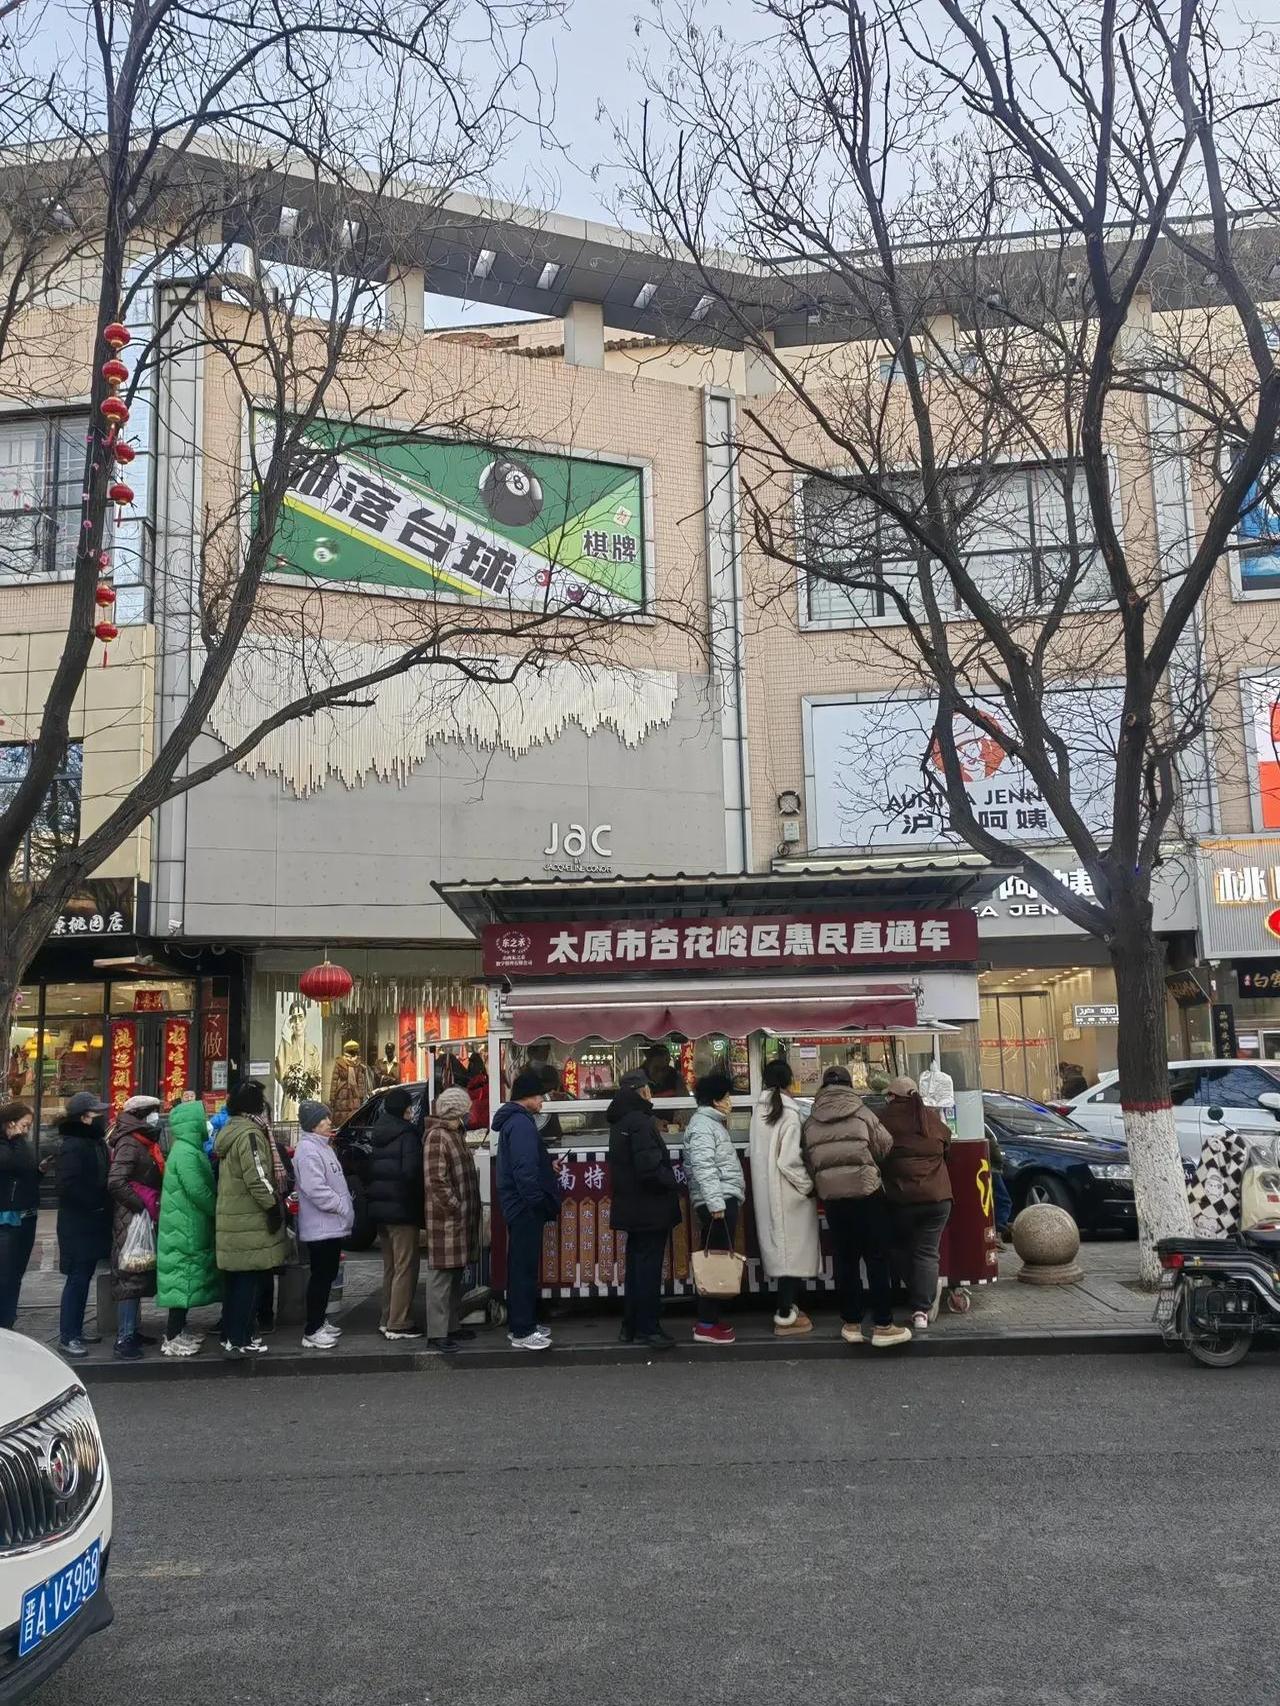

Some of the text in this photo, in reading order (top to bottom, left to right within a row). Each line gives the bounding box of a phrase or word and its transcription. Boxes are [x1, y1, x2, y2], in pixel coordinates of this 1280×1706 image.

[583, 529, 637, 562] 棋牌
[901, 808, 1048, 835] 沪阿姨
[1217, 865, 1280, 902] 桃
[546, 919, 952, 964] 太原市杏花岭区惠民直通车
[24, 1547, 99, 1643] 晋A·V39G8
